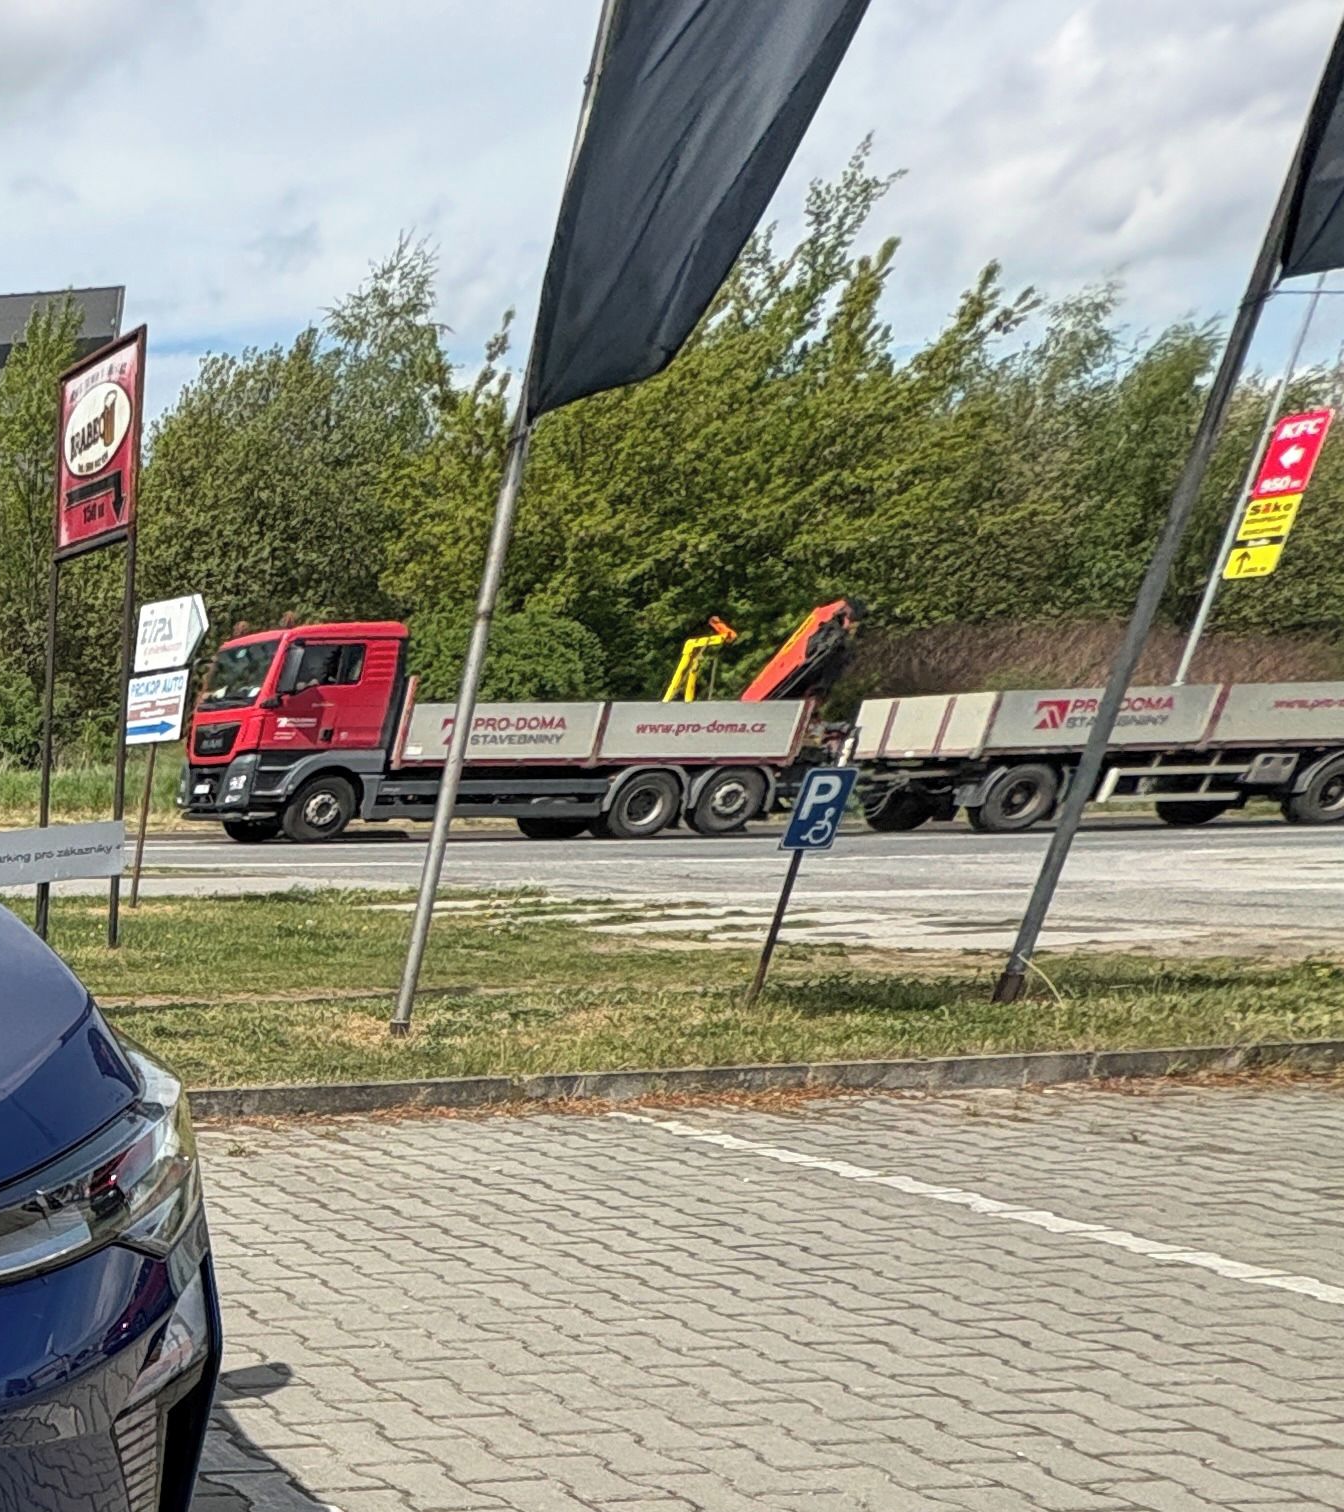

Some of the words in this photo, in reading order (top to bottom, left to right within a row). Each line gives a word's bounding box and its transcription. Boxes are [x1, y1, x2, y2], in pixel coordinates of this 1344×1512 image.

[1277, 418, 1324, 440] KFC
[163, 675, 184, 692] AUTO
[473, 716, 567, 731] PRO-DOMA
[636, 720, 767, 736] www.pro-doma.cz
[470, 733, 564, 745] STAVEBNINY
[798, 775, 842, 820] P
[34, 851, 55, 862] pro
[56, 844, 113, 858] zákazníky
